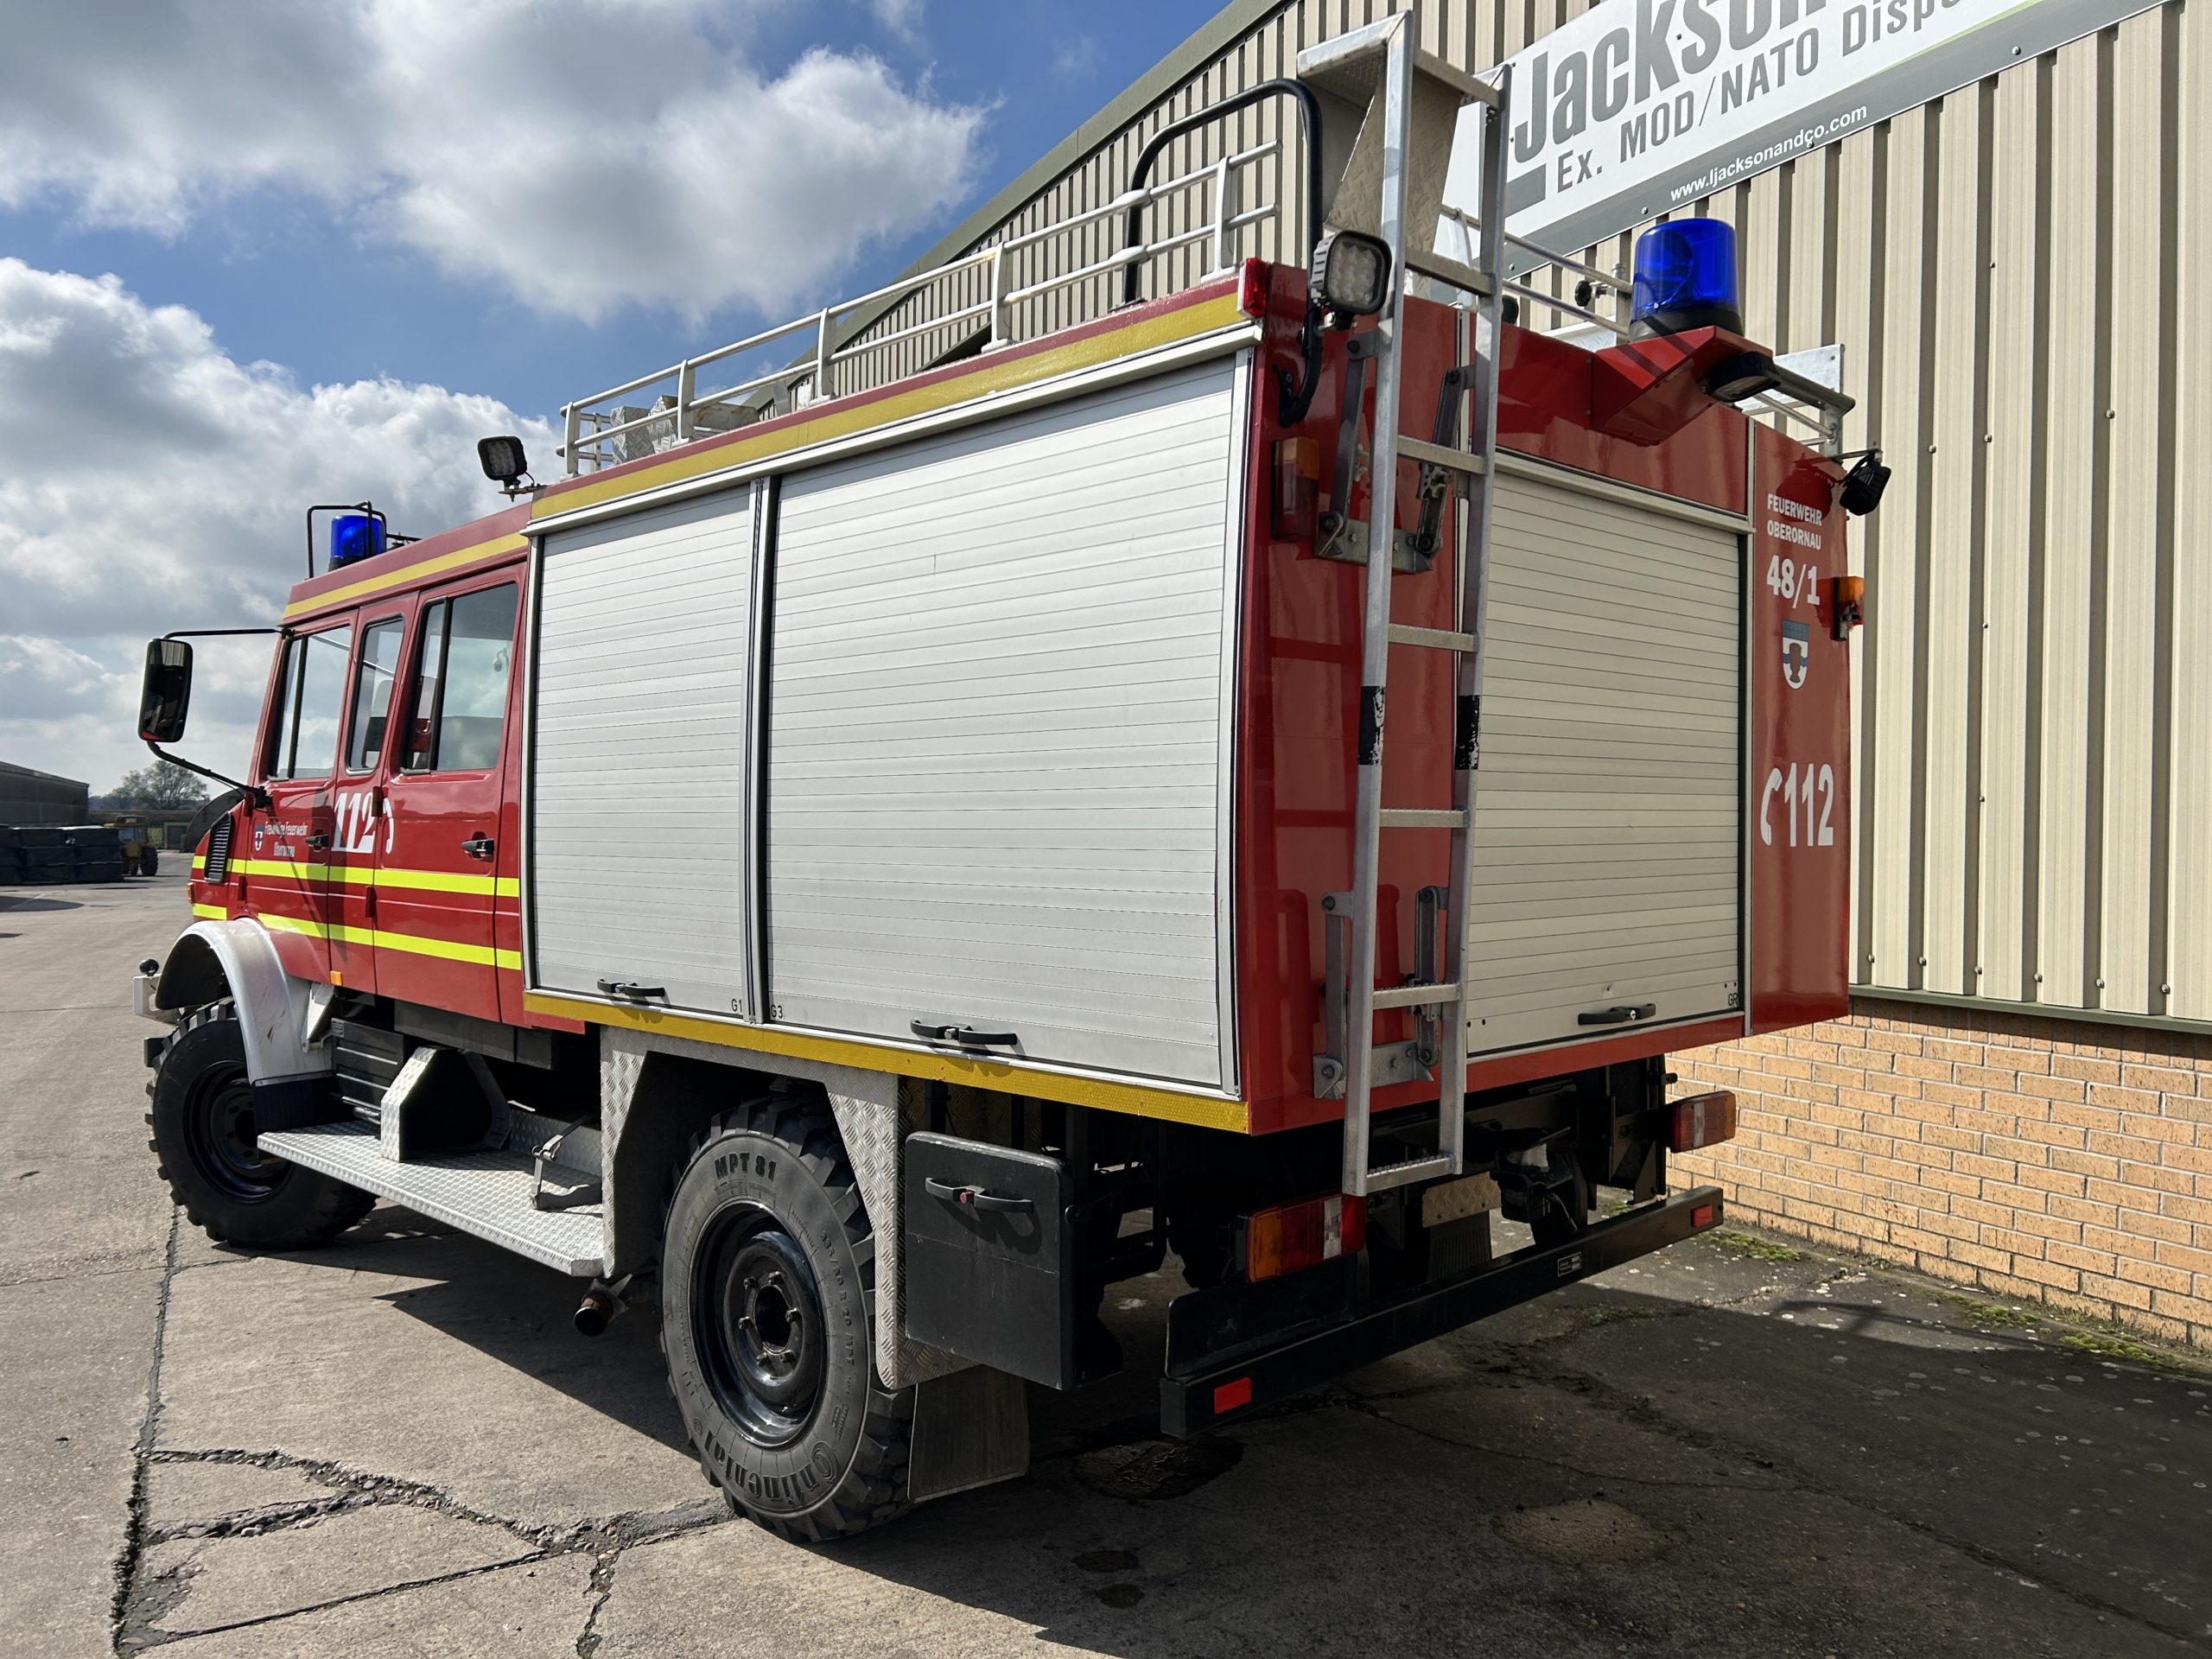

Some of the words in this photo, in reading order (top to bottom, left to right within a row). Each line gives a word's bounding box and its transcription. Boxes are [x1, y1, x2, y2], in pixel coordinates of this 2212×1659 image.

[1557, 149, 1603, 193] Ex.
[1620, 27, 1819, 163] MOD/NATO
[1842, 0, 1960, 56] Disp
[1767, 493, 1822, 526] FEUERWEHR
[1767, 519, 1821, 550] OBERORNAU
[1766, 554, 1821, 608] 48/1
[1784, 762, 1834, 847] 112
[731, 998, 742, 1013] G1
[770, 1004, 783, 1019] G3
[1728, 993, 1738, 1007] GR
[714, 1152, 750, 1179] MPT
[755, 1154, 777, 1182] 81
